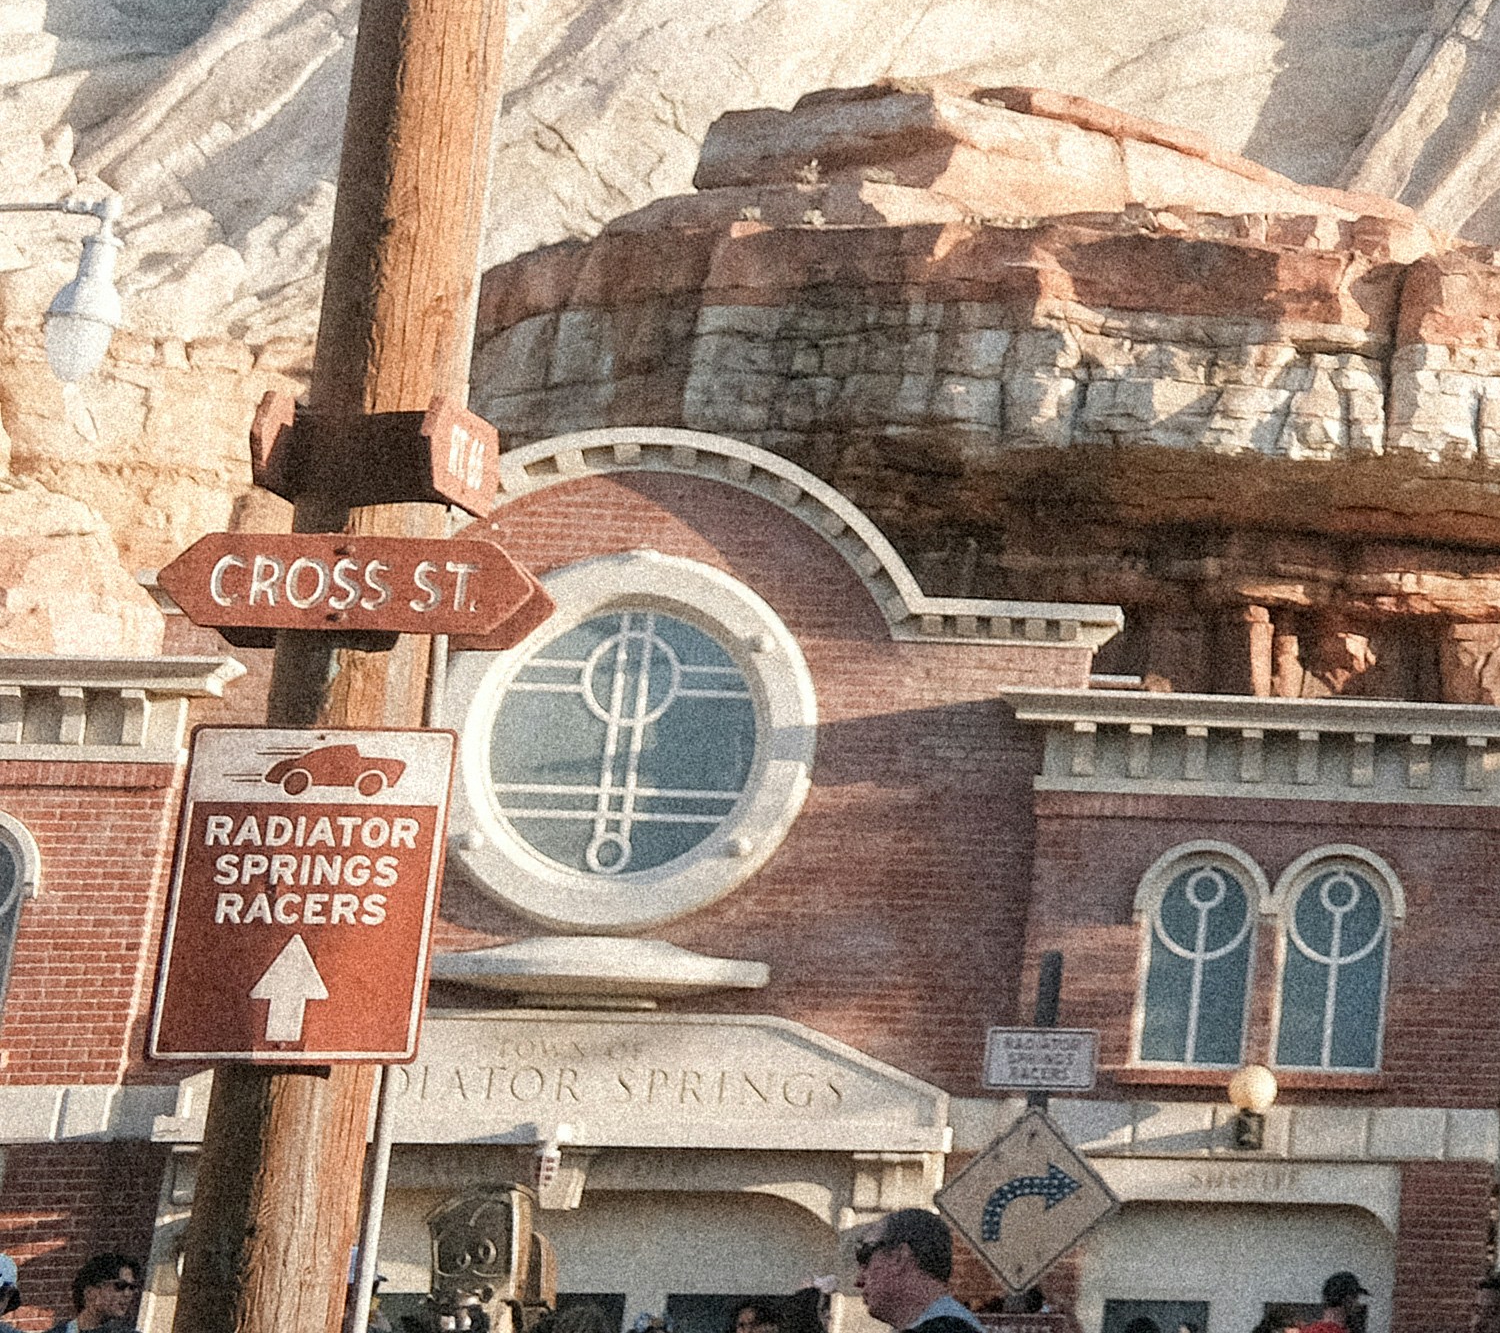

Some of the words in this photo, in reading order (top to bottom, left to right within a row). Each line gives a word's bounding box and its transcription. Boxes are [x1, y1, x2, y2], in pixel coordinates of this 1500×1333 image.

[209, 554, 392, 613] CROSS
[409, 560, 479, 613] ST.
[204, 815, 420, 850] RADIATOR
[213, 853, 400, 888] SPRINGS
[214, 891, 388, 926] RACERS
[498, 1037, 589, 1062] TOWN
[604, 1041, 646, 1061] OF
[614, 1067, 846, 1109] SPRINGS
